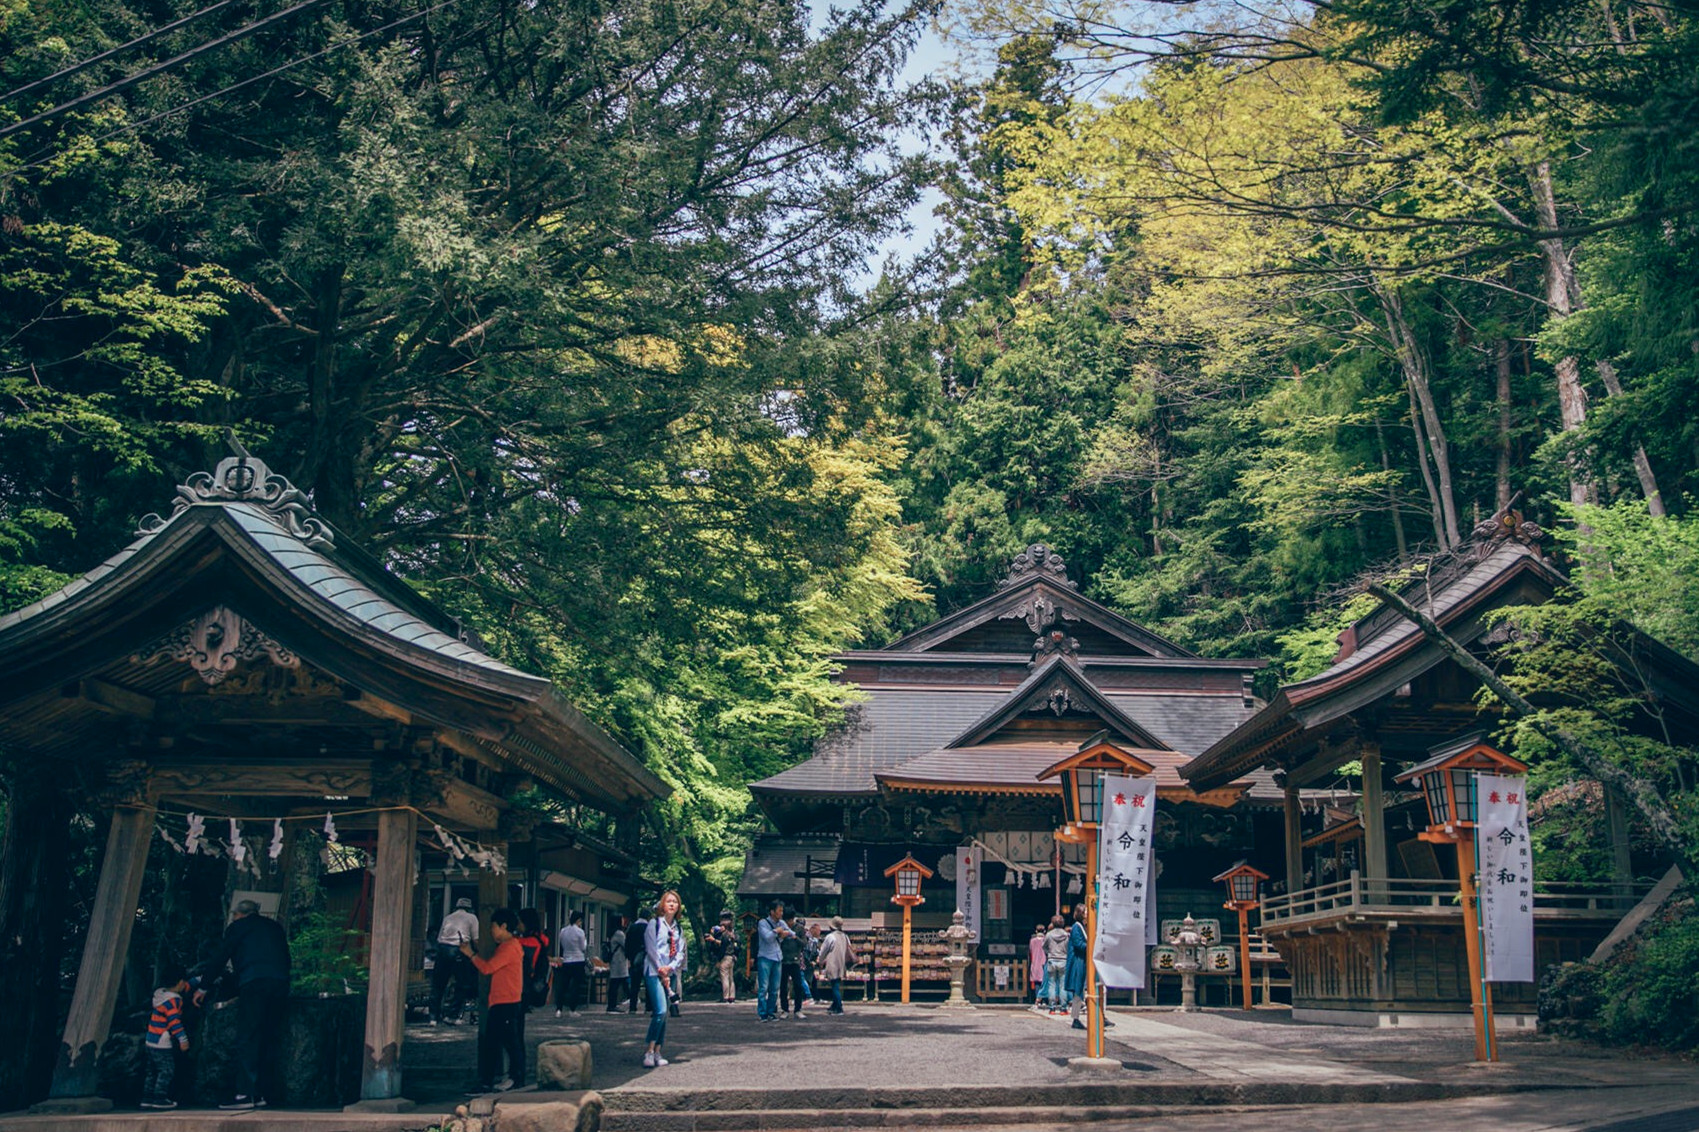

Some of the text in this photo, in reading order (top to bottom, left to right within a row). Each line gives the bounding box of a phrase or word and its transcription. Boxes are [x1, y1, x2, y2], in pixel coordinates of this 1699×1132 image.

[1113, 792, 1146, 808] 奉祝
[1489, 790, 1520, 804] 奉祝
[1112, 830, 1136, 891] 令和
[1132, 824, 1147, 919] 天皇陛下御即位
[1496, 826, 1516, 885] 令和
[1517, 820, 1528, 913] 天皇陛下御即位
